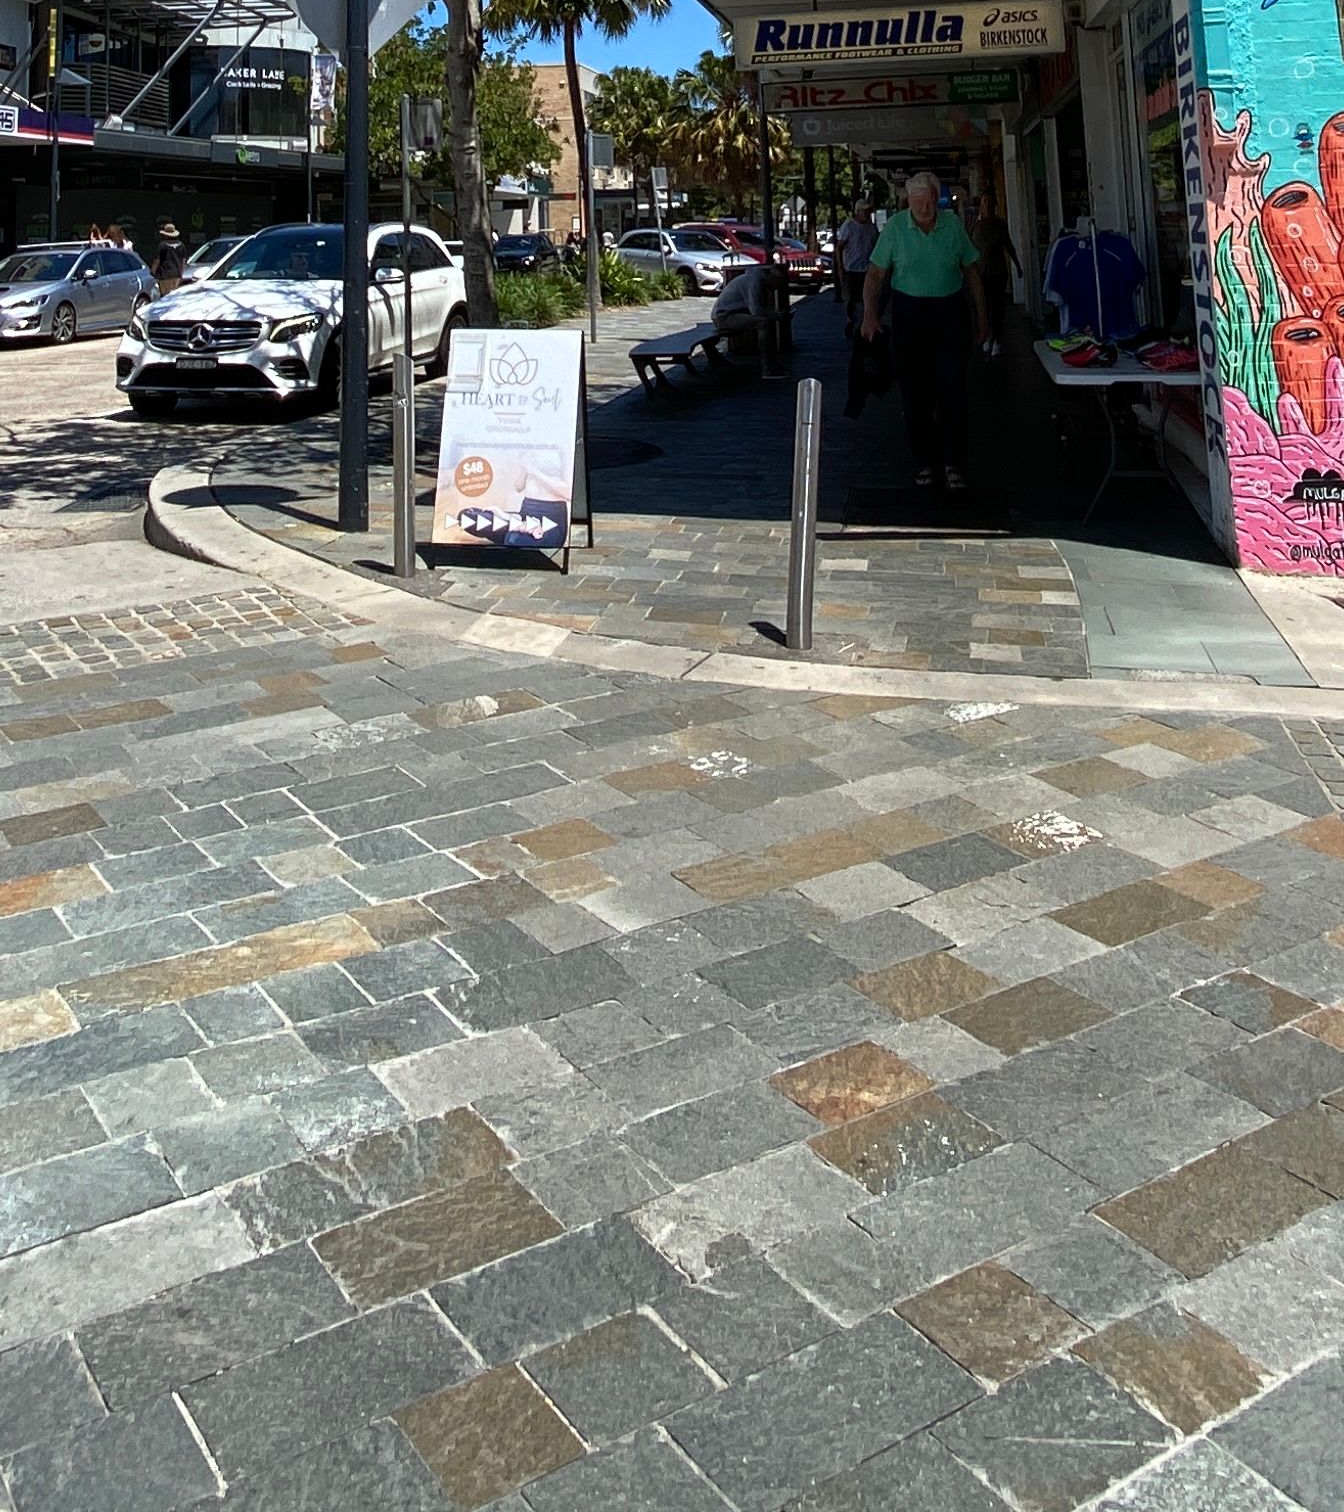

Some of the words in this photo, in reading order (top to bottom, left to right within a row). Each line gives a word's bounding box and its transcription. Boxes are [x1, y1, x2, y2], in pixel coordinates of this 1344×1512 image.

[754, 9, 965, 54] Runnulla
[1001, 9, 1039, 25] asics
[979, 28, 1048, 48] BIRKENSTOCK
[754, 52, 833, 64] PERFORMANCE
[835, 48, 892, 59] FOOTWEAR
[907, 44, 960, 55] CLOTHING
[1175, 14, 1227, 466] BIRKENSTOCK
[460, 392, 519, 409] HEART
[462, 460, 484, 476] $48
